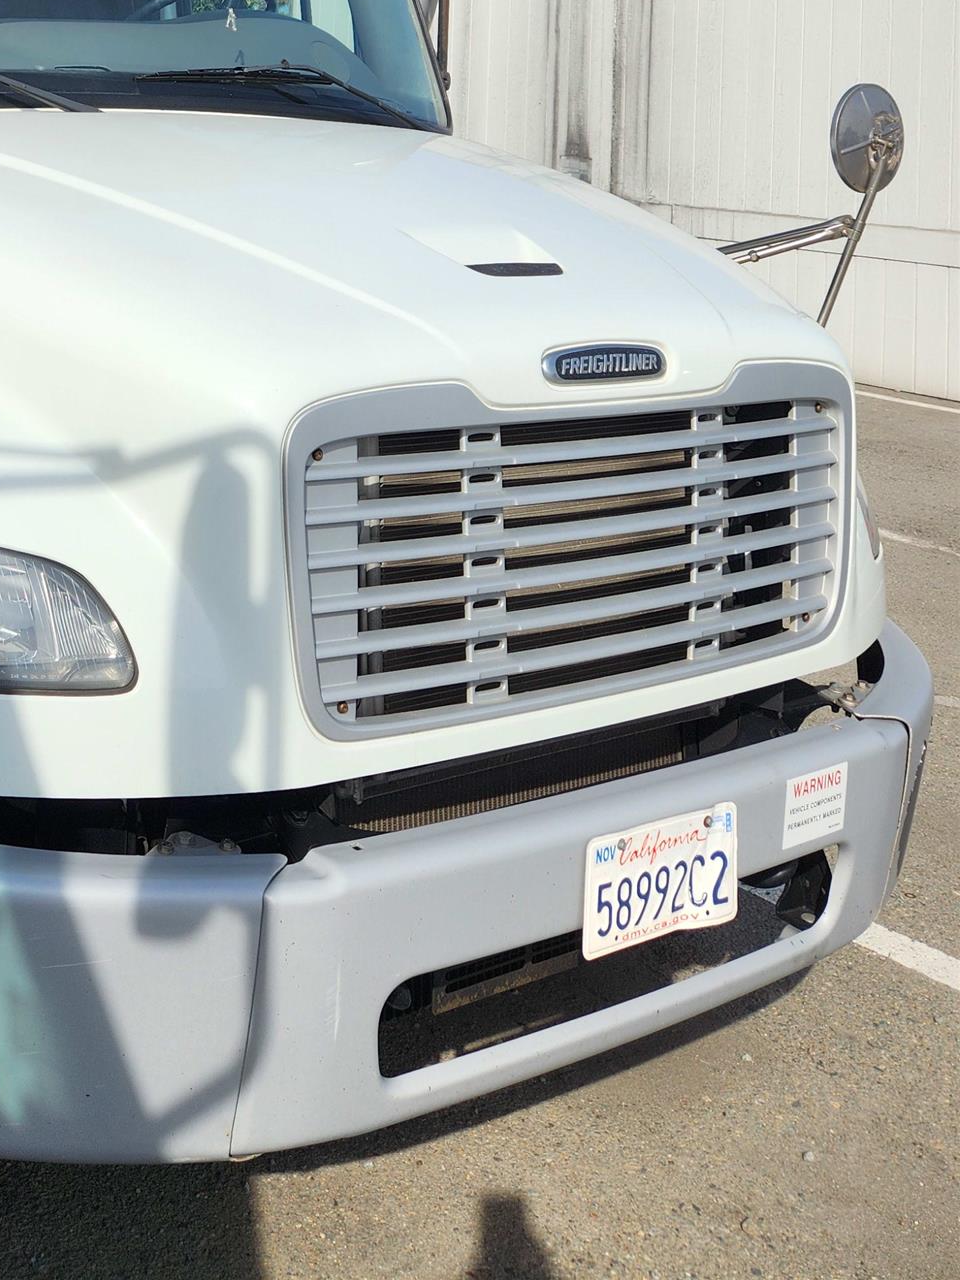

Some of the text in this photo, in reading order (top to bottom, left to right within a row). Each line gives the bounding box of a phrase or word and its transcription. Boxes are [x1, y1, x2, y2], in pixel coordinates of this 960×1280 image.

[561, 353, 658, 375] FREIGHTLINER
[793, 770, 841, 798] WARNING
[789, 792, 842, 815] VEHICLE COMPONENTS
[787, 814, 821, 831] PERMANENTLY
[822, 807, 842, 819] MARKED
[595, 829, 709, 866] NOV California
[597, 850, 729, 937] 58992C2
[622, 913, 699, 941] dmv.ca.gov
